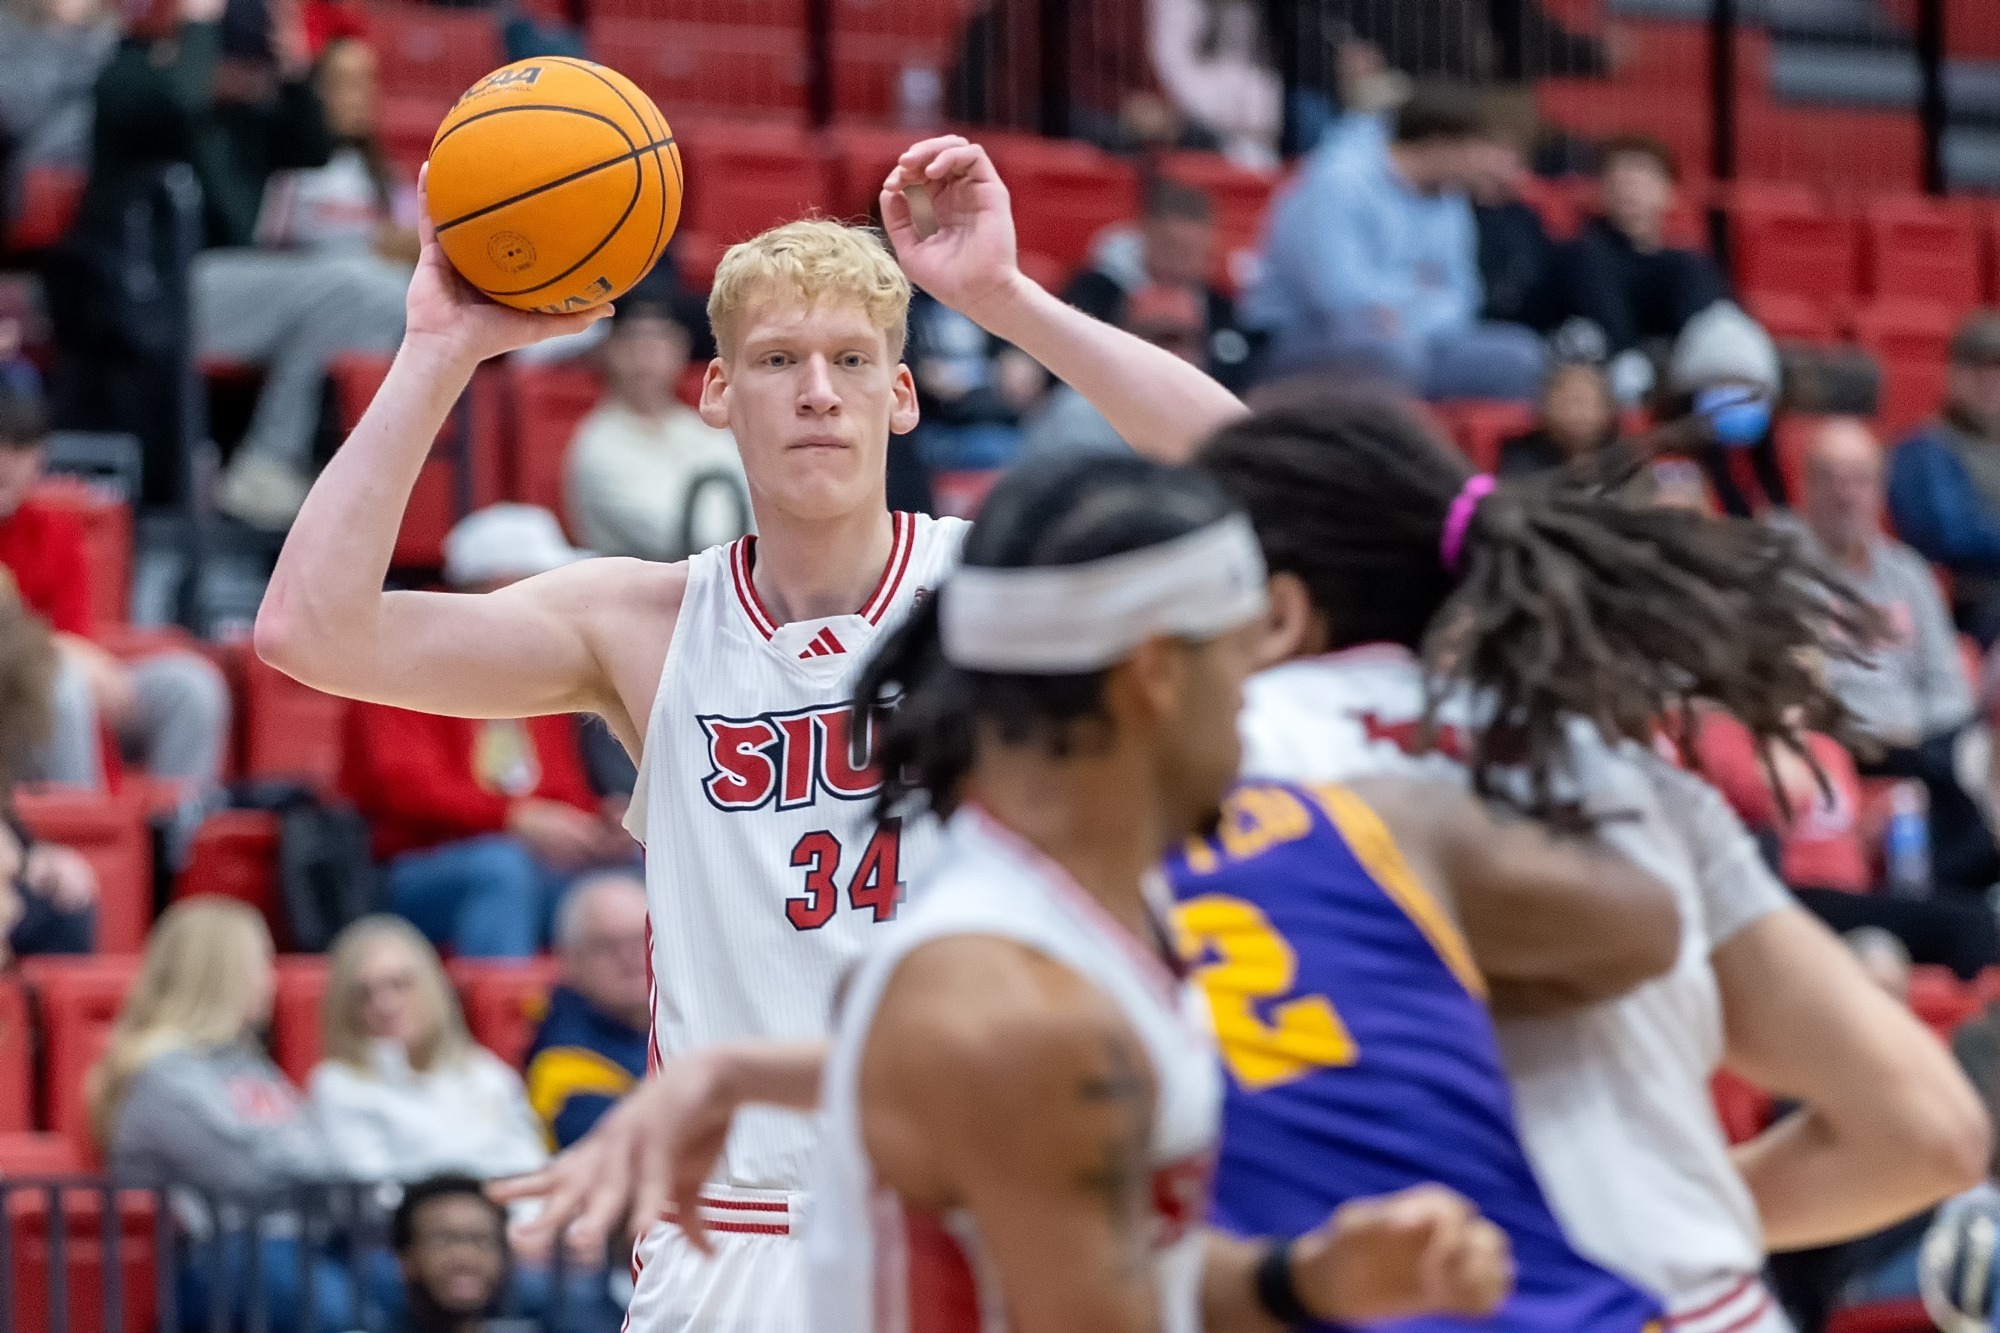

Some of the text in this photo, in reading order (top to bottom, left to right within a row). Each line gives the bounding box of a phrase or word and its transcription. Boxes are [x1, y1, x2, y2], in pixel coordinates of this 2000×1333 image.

[695, 690, 915, 812] SIU
[785, 816, 907, 931] 34
[1169, 892, 1360, 1092] 2
